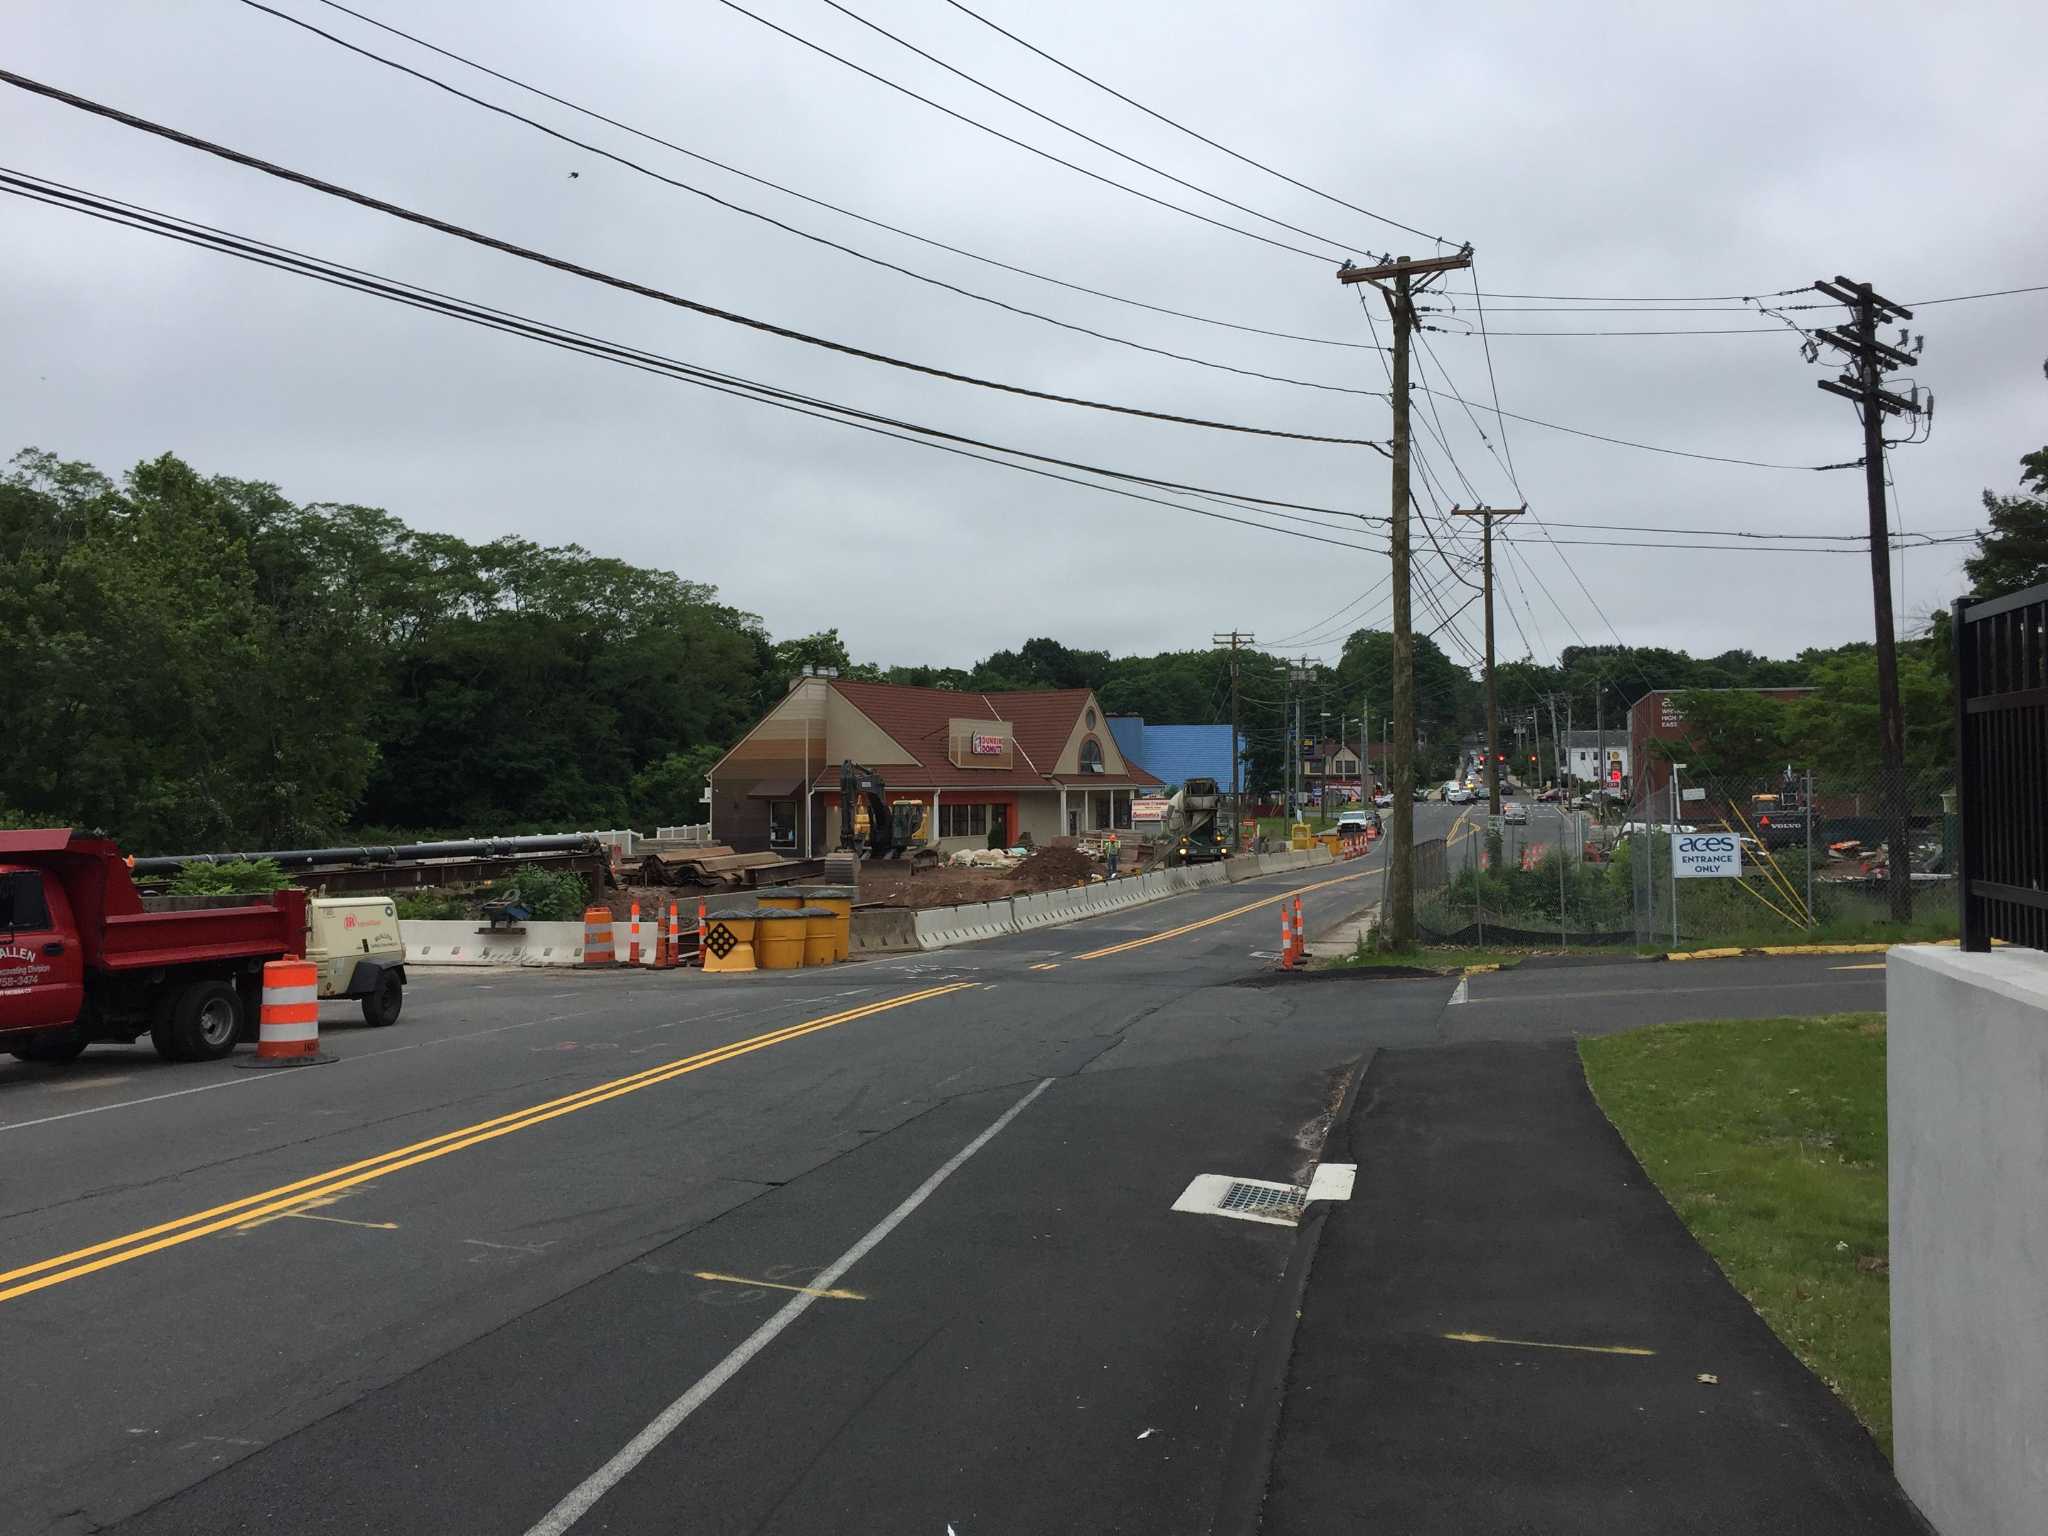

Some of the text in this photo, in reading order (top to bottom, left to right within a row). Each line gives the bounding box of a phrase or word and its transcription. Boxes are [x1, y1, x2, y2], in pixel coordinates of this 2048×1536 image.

[1679, 837, 1734, 852] aces
[1682, 855, 1732, 863] ENTRANCE
[1695, 865, 1720, 873] ONLY
[0, 975, 38, 987] 58-3474
